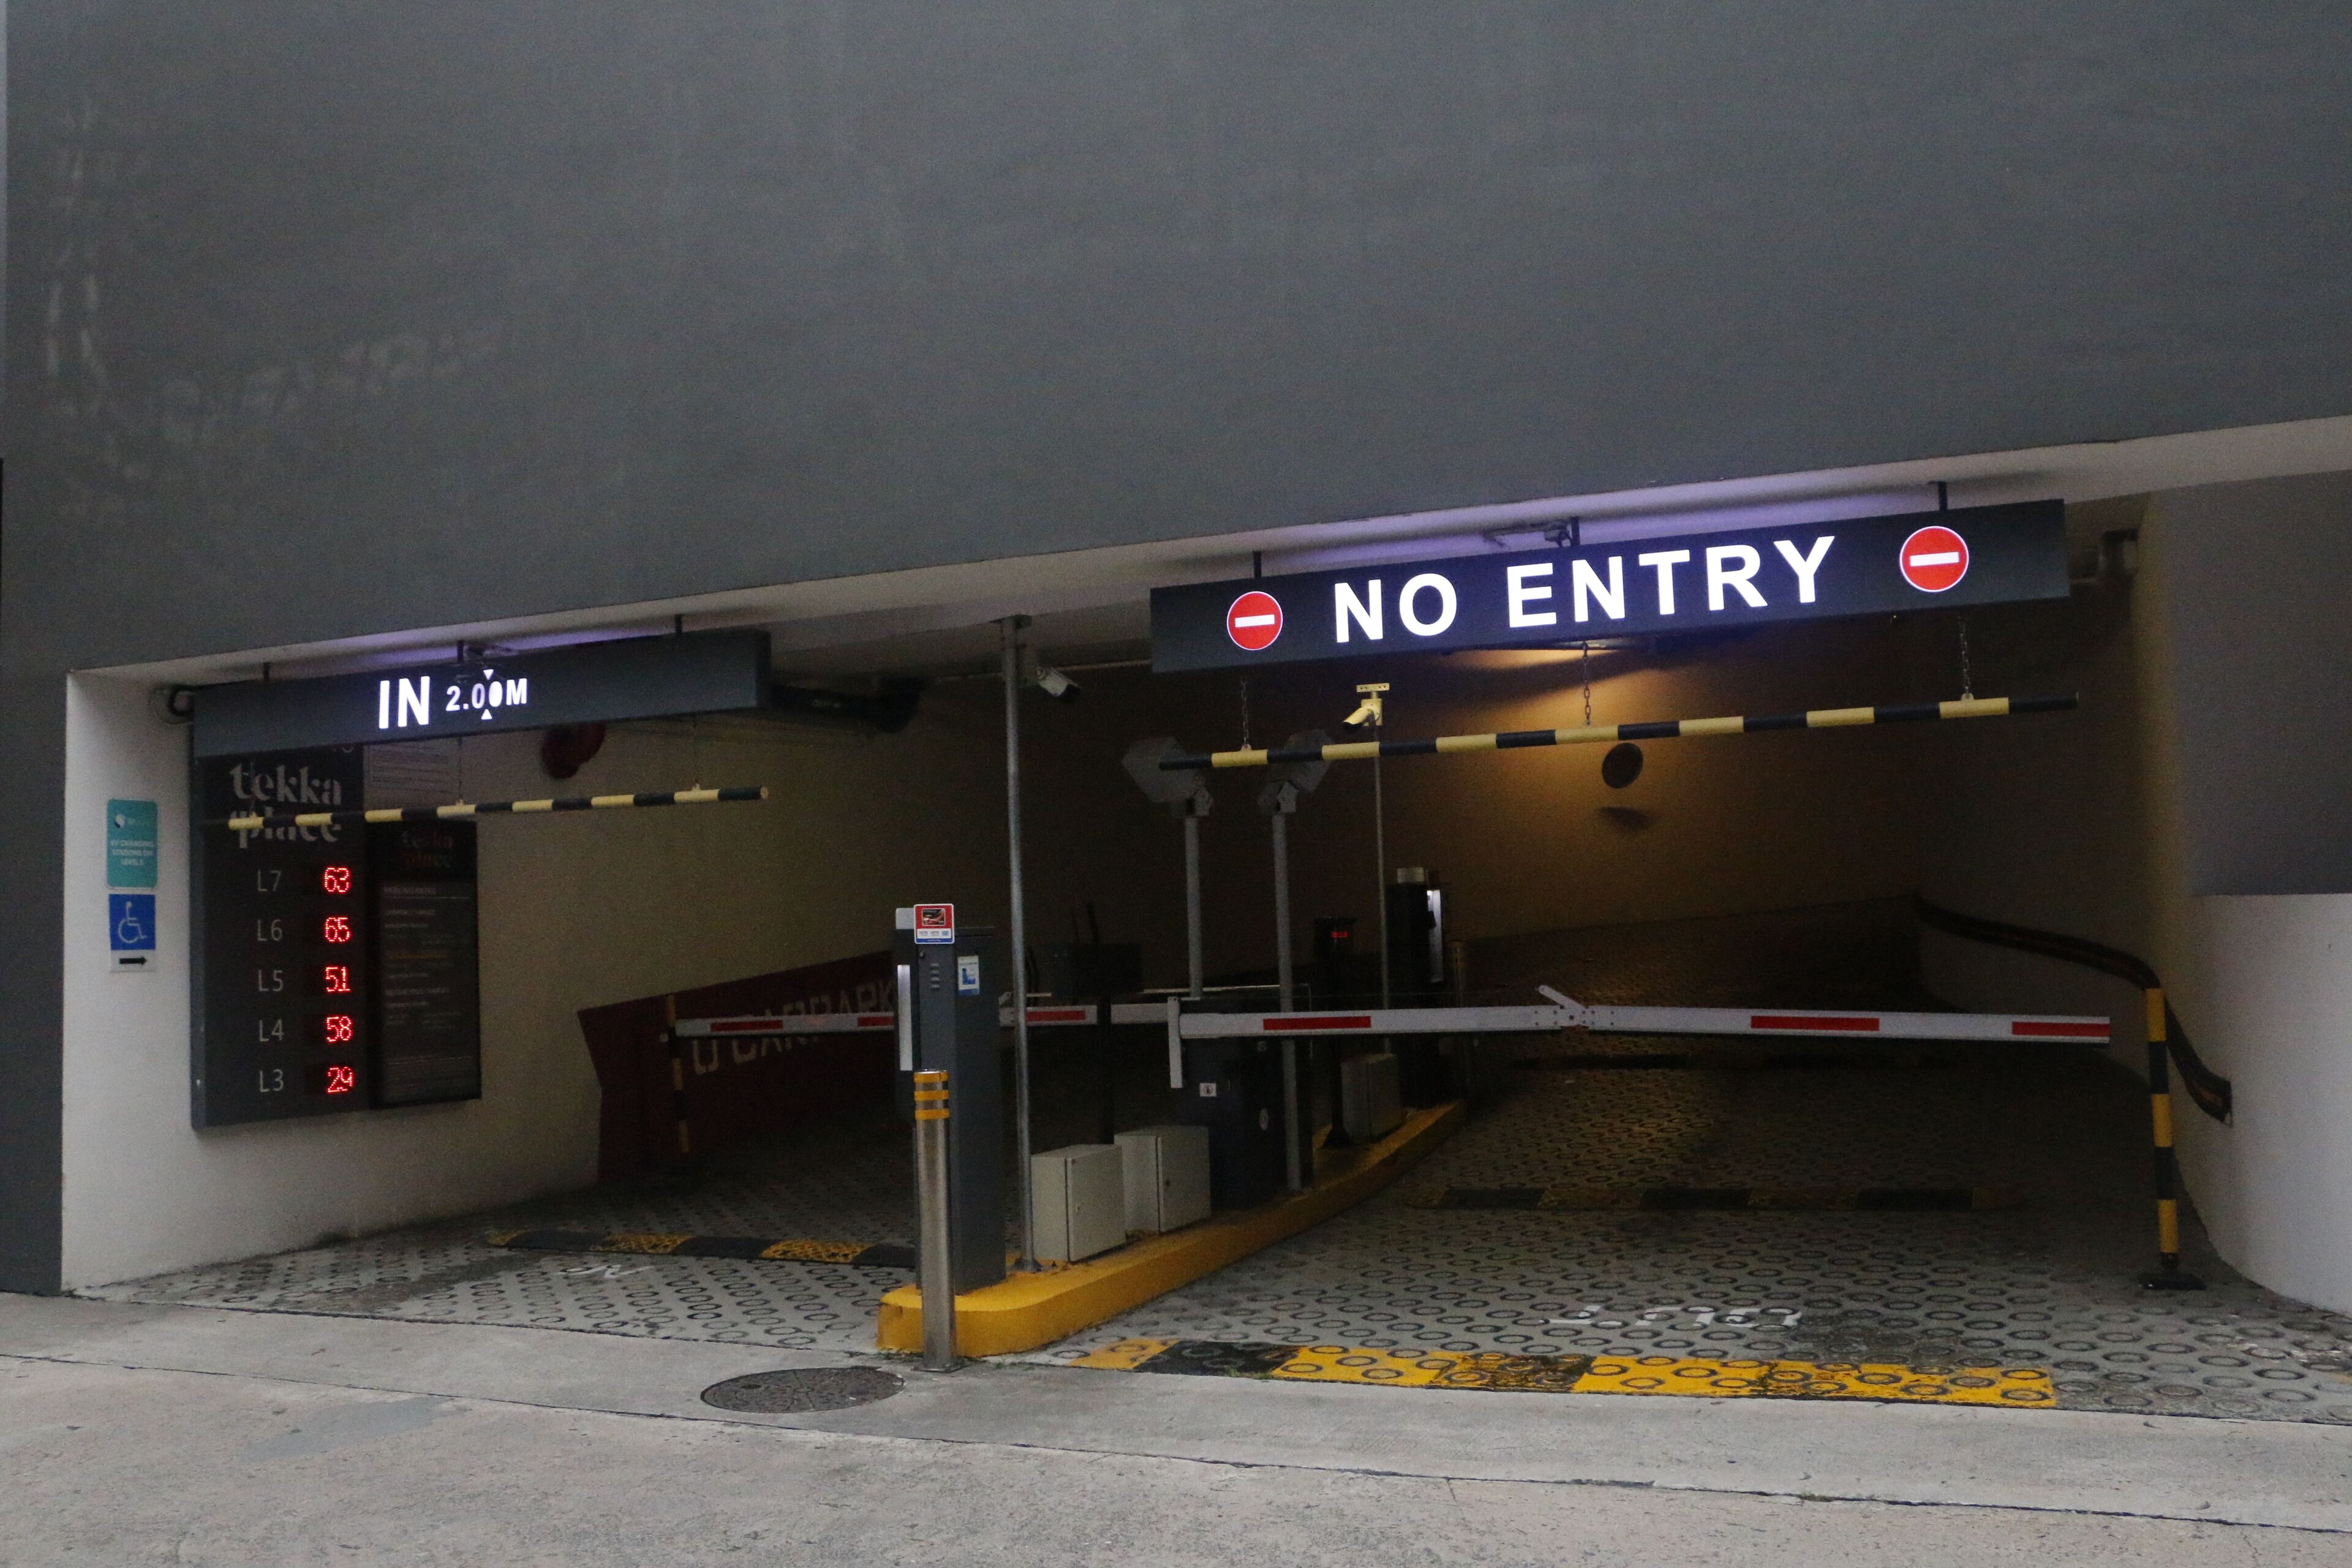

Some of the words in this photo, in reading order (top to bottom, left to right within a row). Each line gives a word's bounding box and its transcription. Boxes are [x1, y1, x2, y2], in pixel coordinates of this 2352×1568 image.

[1334, 573, 1458, 644] NO
[1507, 535, 1836, 629] ENTRY
[379, 676, 431, 729] IN
[445, 677, 528, 712] 2.00M
[229, 763, 342, 805] tekka
[257, 870, 282, 892] L7
[324, 867, 350, 893] 63
[257, 919, 283, 941] L6
[325, 916, 350, 943] 65
[258, 969, 284, 992] L5
[325, 966, 351, 992] 51
[258, 1019, 284, 1042] L4
[326, 1016, 352, 1042] 58
[259, 1068, 284, 1093] L3
[327, 1066, 353, 1093] 29
